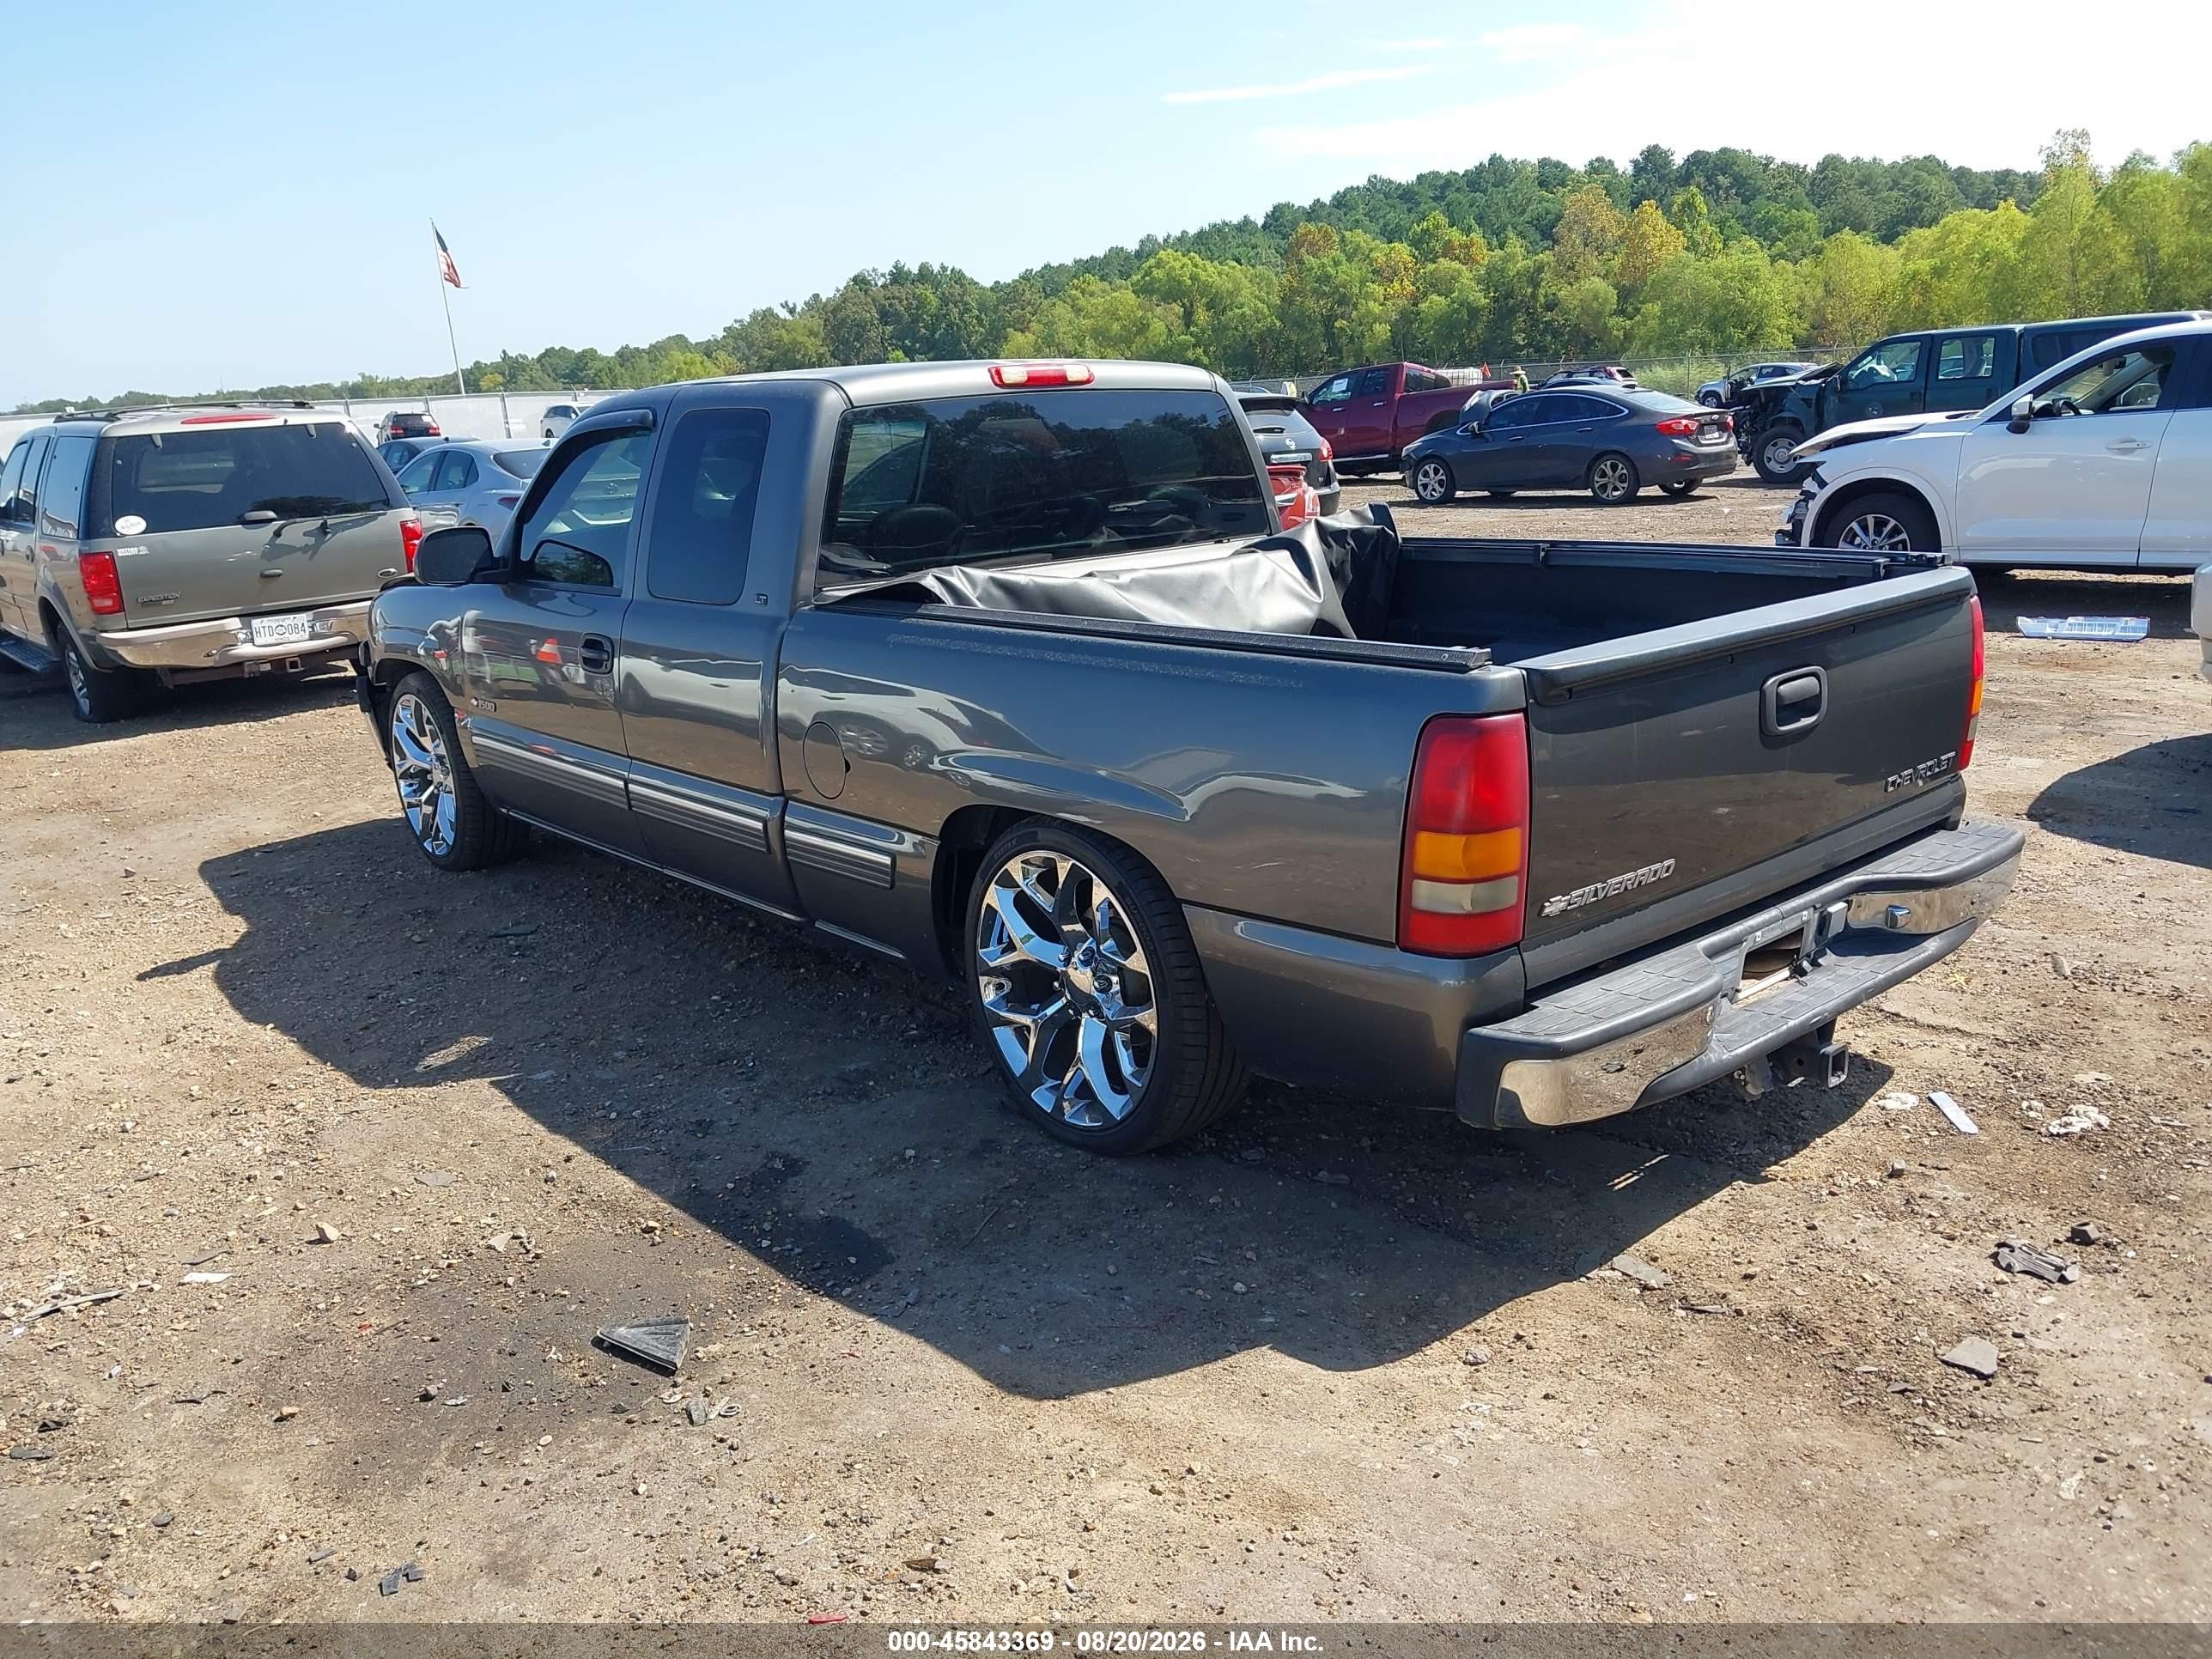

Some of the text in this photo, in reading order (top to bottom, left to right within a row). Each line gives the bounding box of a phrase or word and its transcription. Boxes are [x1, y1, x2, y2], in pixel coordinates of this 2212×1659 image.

[254, 623, 307, 639] HTD 084
[477, 699, 495, 712] 1500
[1887, 750, 1957, 793] CHEVROLET
[1565, 857, 1677, 911] SILVERADO
